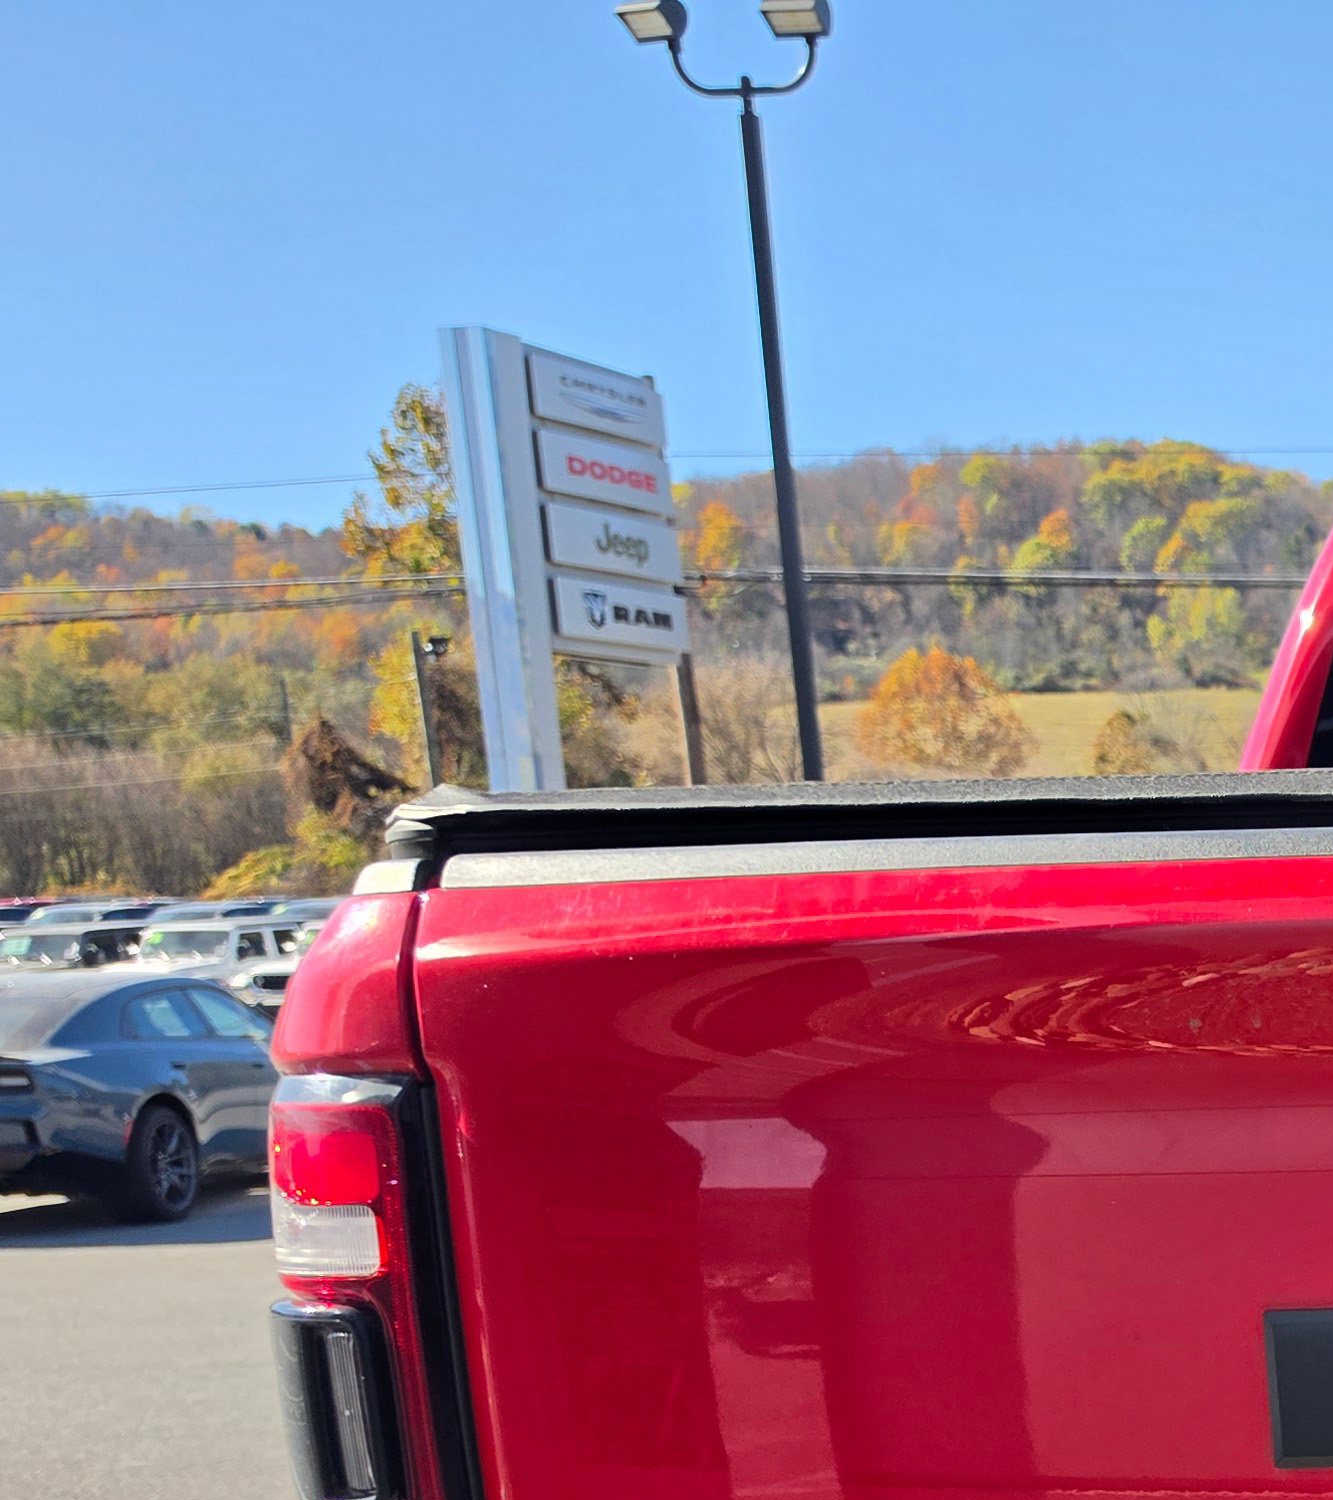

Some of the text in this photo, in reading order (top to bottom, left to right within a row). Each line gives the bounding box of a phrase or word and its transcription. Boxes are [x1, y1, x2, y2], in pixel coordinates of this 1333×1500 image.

[567, 456, 658, 493] DODGE
[596, 524, 649, 567] Jeep
[614, 605, 672, 630] RAM
